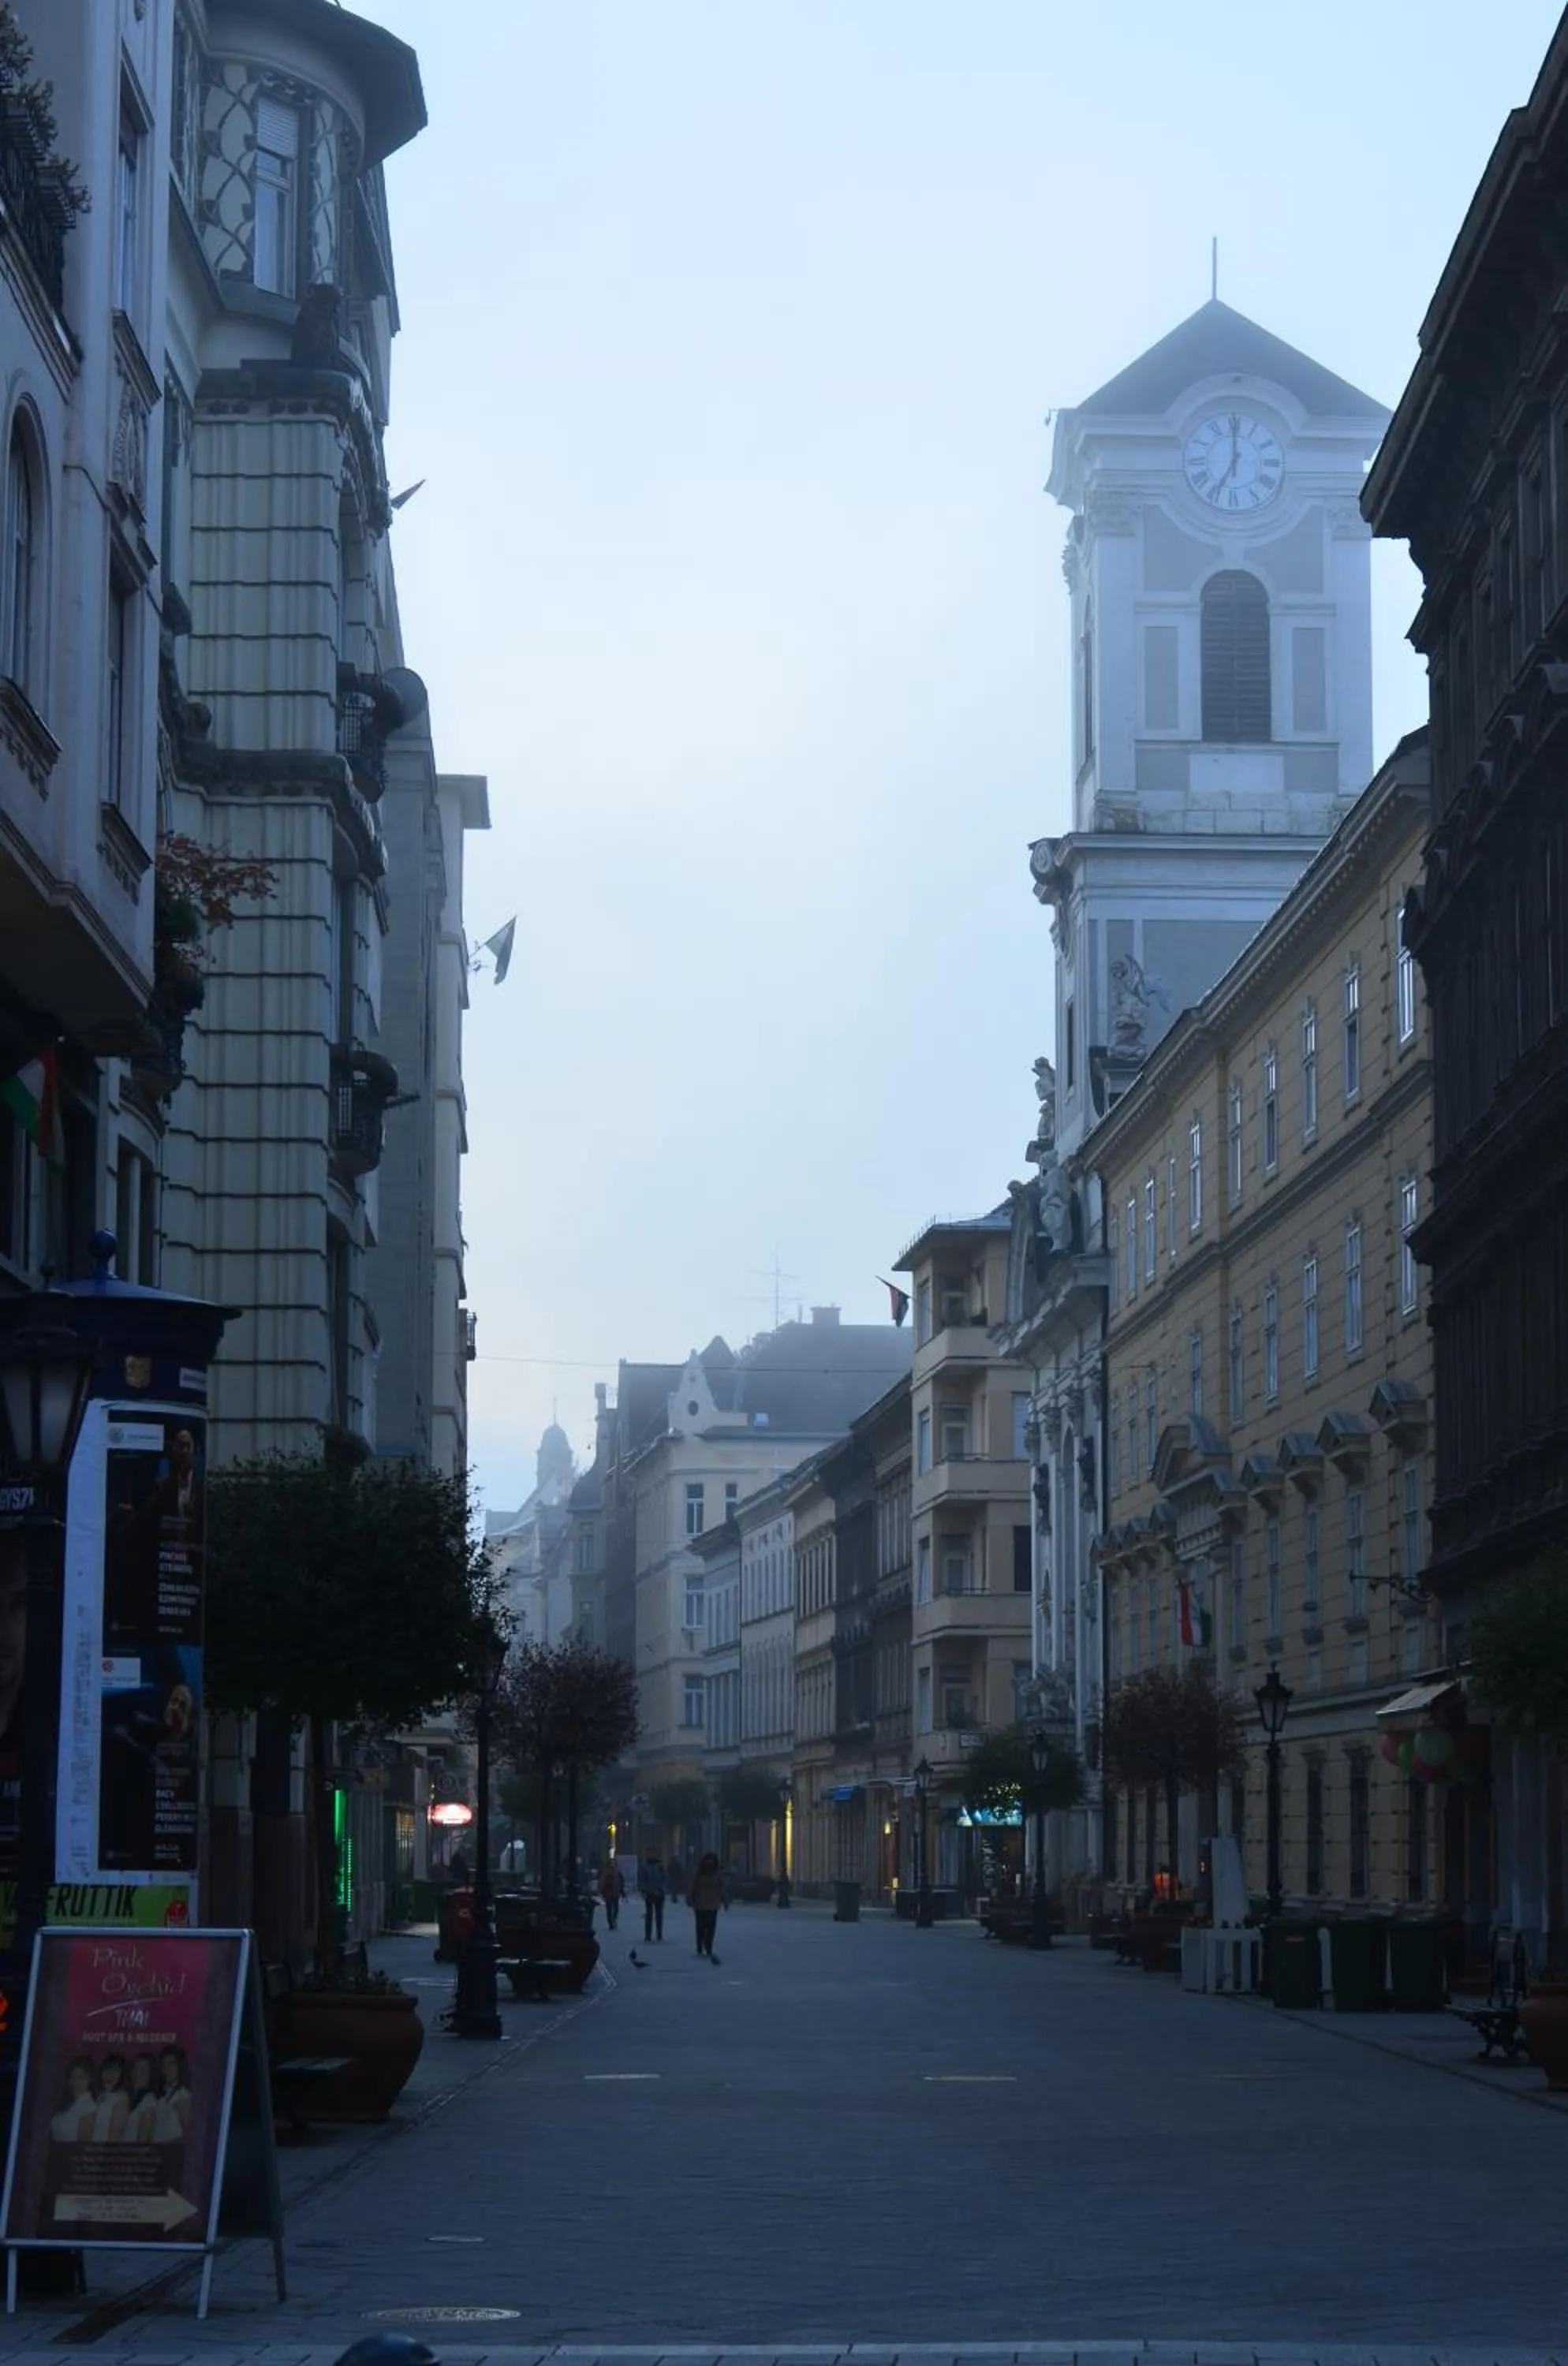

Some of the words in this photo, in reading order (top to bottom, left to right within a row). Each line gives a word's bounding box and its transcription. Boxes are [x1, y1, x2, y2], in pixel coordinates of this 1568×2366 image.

[91, 1942, 146, 1970] Pink
[101, 1970, 186, 1998] Orchid
[114, 2008, 150, 2028] THAI
